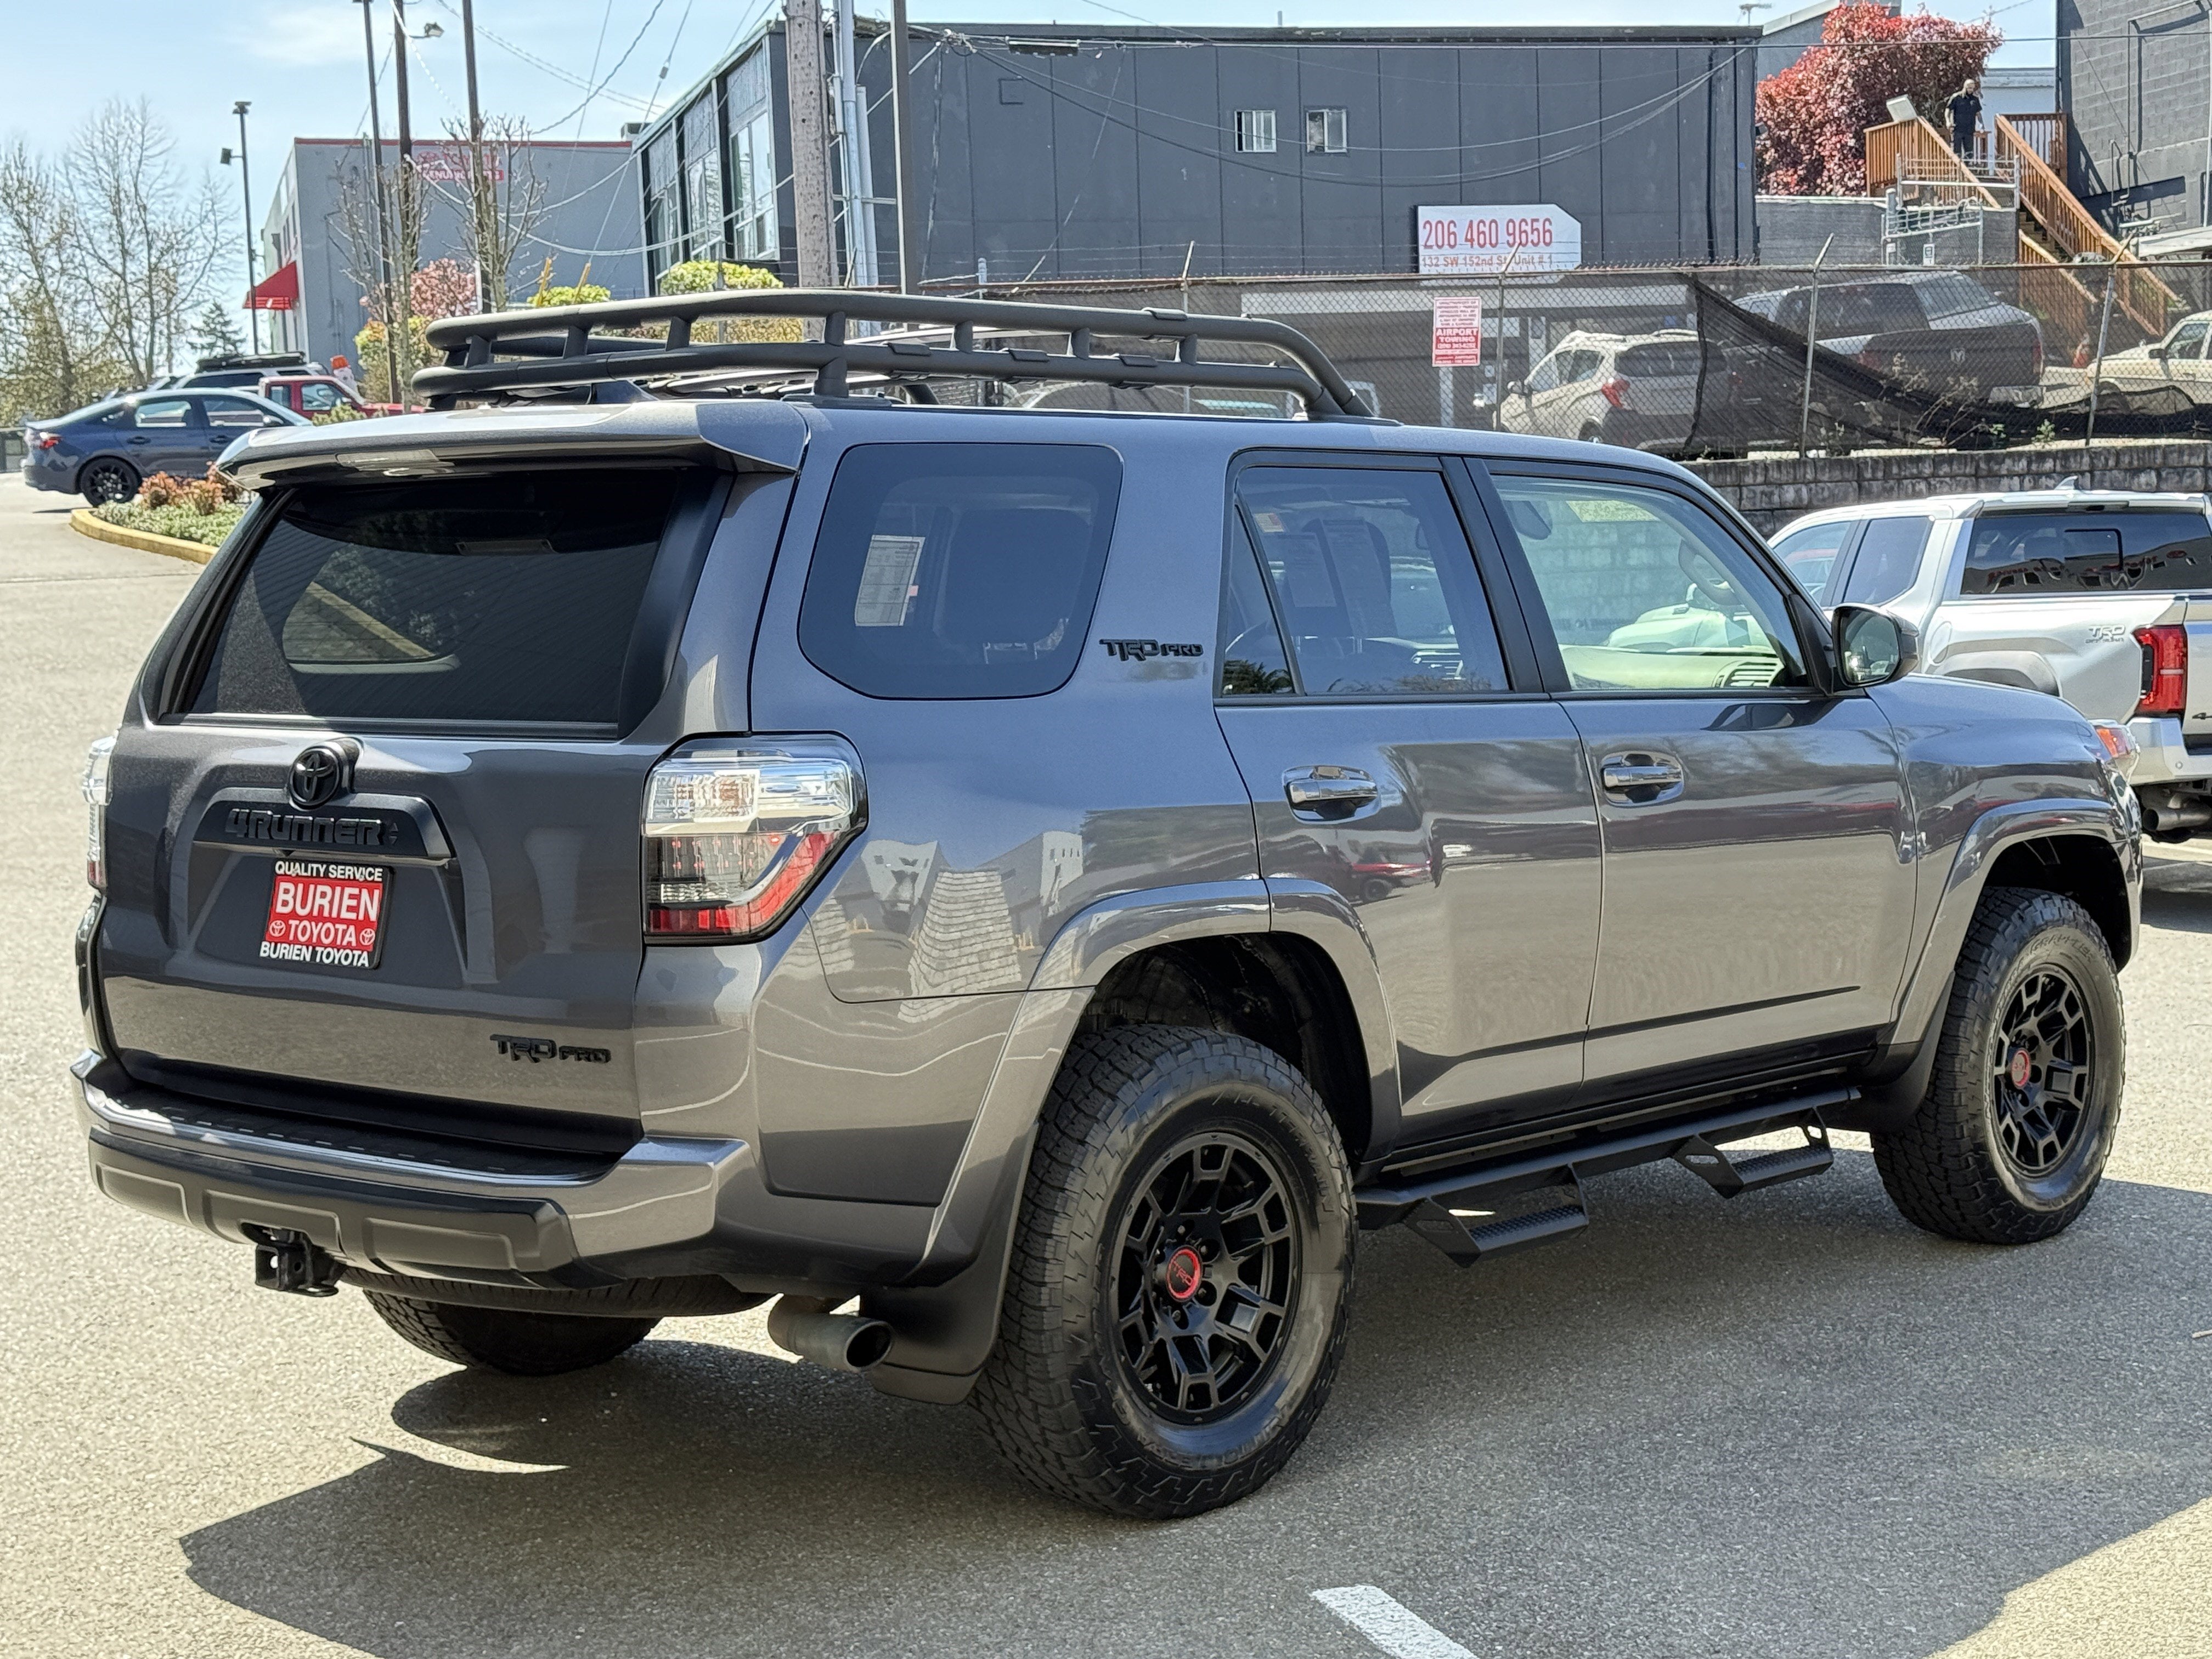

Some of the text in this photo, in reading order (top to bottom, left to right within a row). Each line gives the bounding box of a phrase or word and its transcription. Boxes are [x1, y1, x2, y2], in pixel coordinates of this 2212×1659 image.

[1423, 217, 1553, 250] 206 460 9656
[1422, 256, 1440, 267] 132
[1443, 256, 1459, 267] SW
[1463, 255, 1493, 266] 152nd
[1514, 254, 1534, 266] Unit
[2088, 625, 2125, 641] TRD
[1099, 639, 1204, 661] TRD PRO
[225, 809, 383, 845] 4RUNNER
[275, 861, 383, 882] QUALITY SERVICE
[275, 882, 380, 922] BURIEN
[289, 919, 357, 946] TOYOTA
[259, 941, 369, 967] BURIEN TOYOTA
[490, 1034, 611, 1063] TRD PRO
